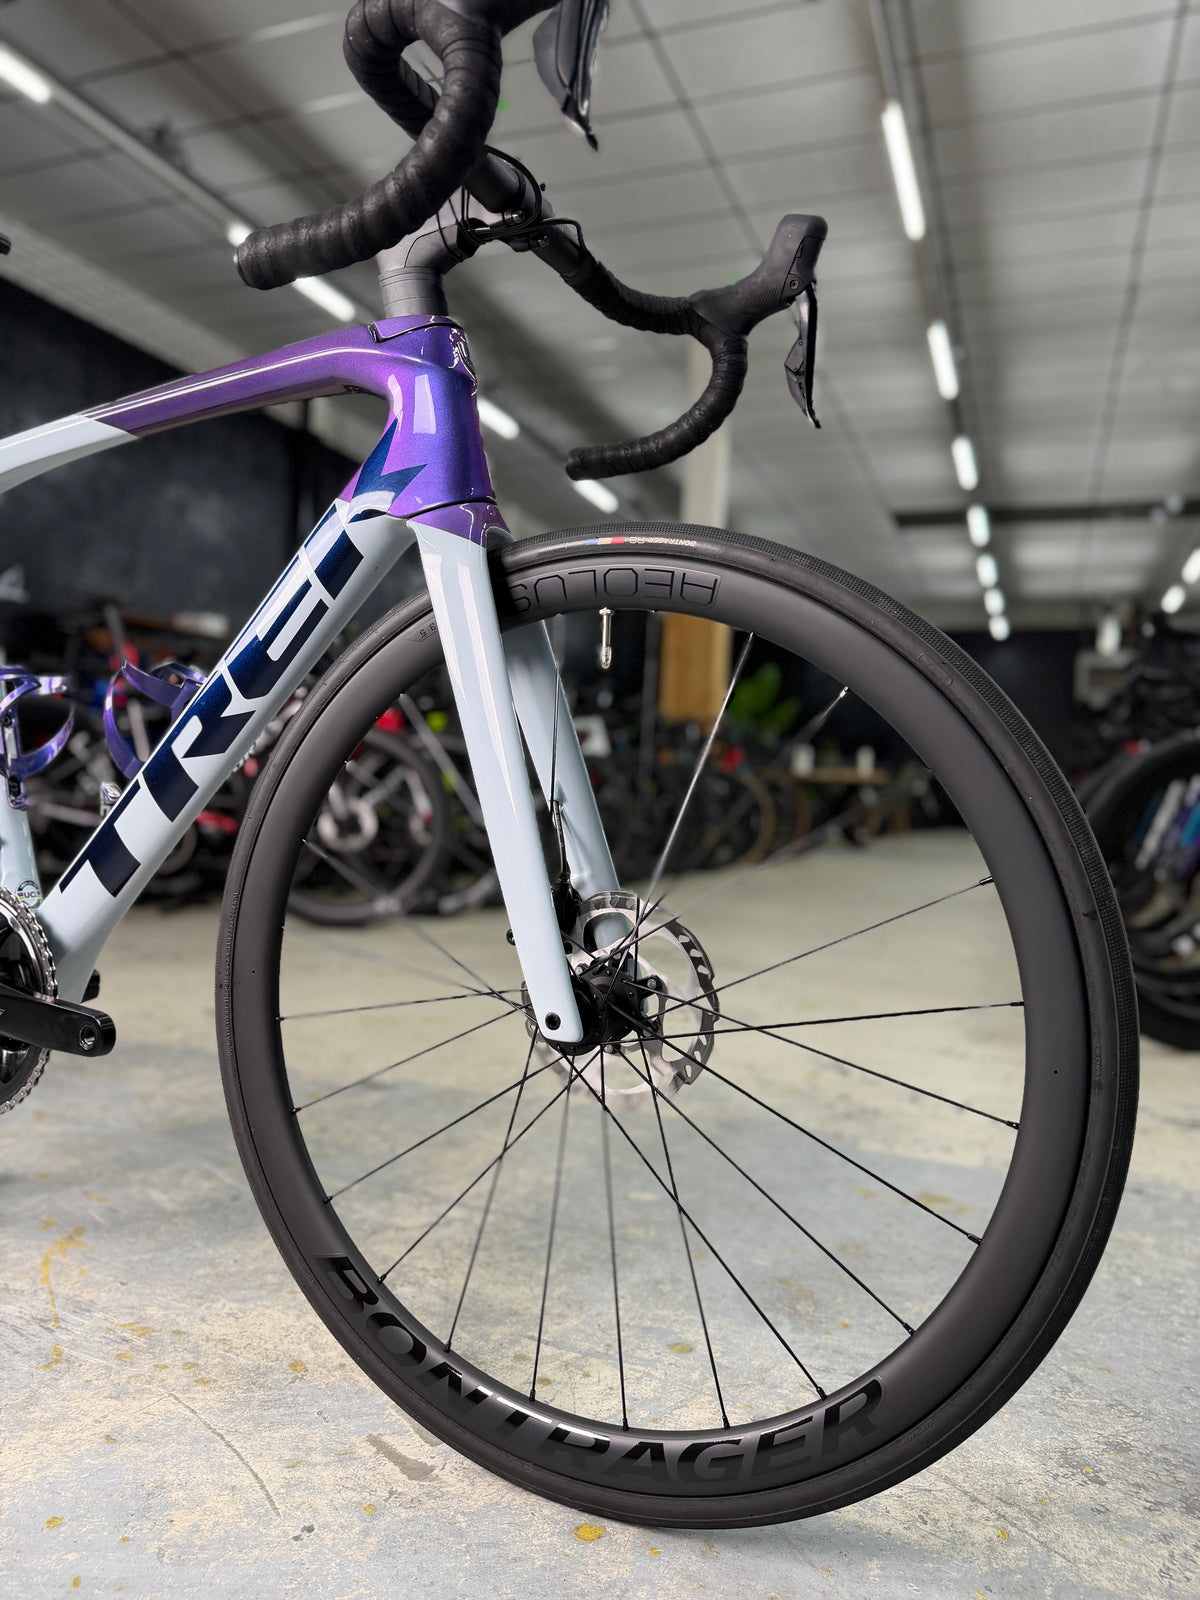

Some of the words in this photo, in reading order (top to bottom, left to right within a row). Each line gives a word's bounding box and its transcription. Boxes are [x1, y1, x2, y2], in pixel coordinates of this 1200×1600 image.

[508, 568, 718, 613] AEOLUS
[648, 536, 697, 547] BONTRAGER
[59, 419, 427, 897] TREK
[315, 1256, 884, 1483] BONTRAGER
